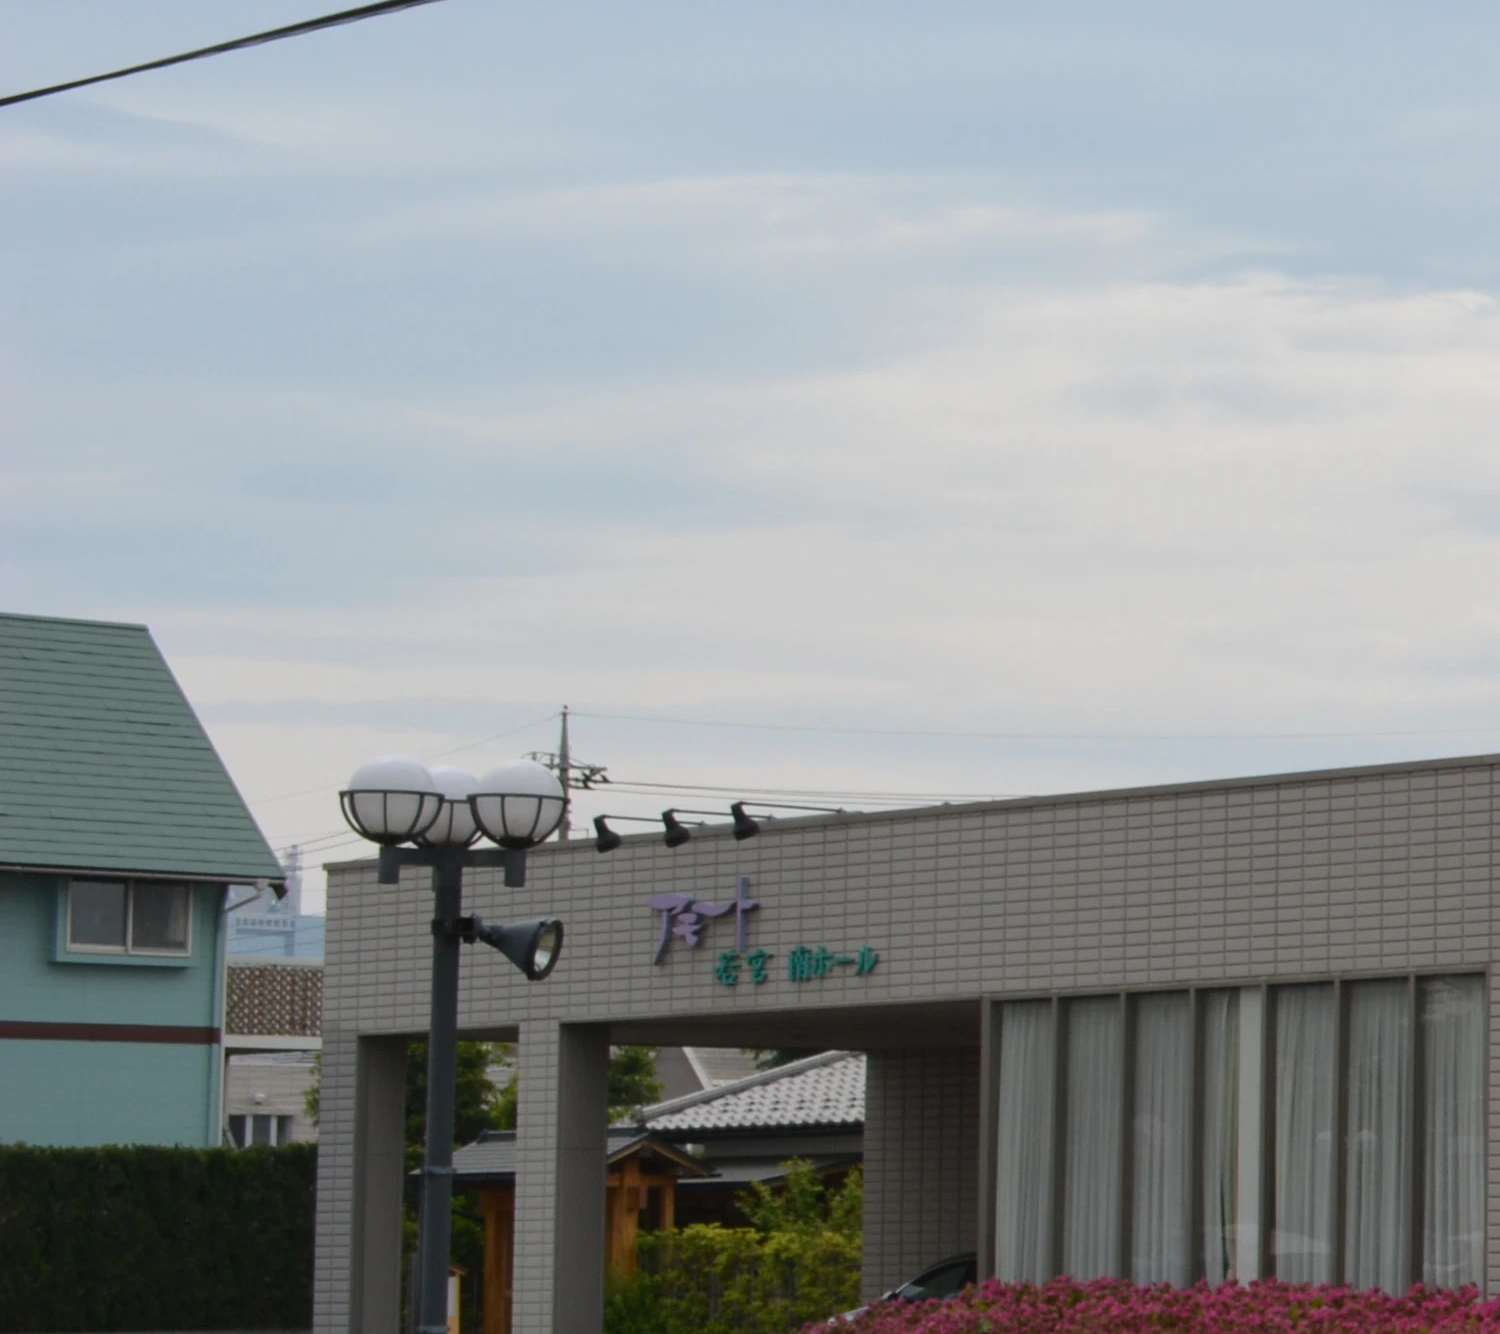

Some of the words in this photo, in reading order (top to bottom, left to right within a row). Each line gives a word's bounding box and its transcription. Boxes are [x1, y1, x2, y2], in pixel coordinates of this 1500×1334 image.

[715, 948, 773, 986] 若宮
[788, 943, 879, 982] 南ホール
